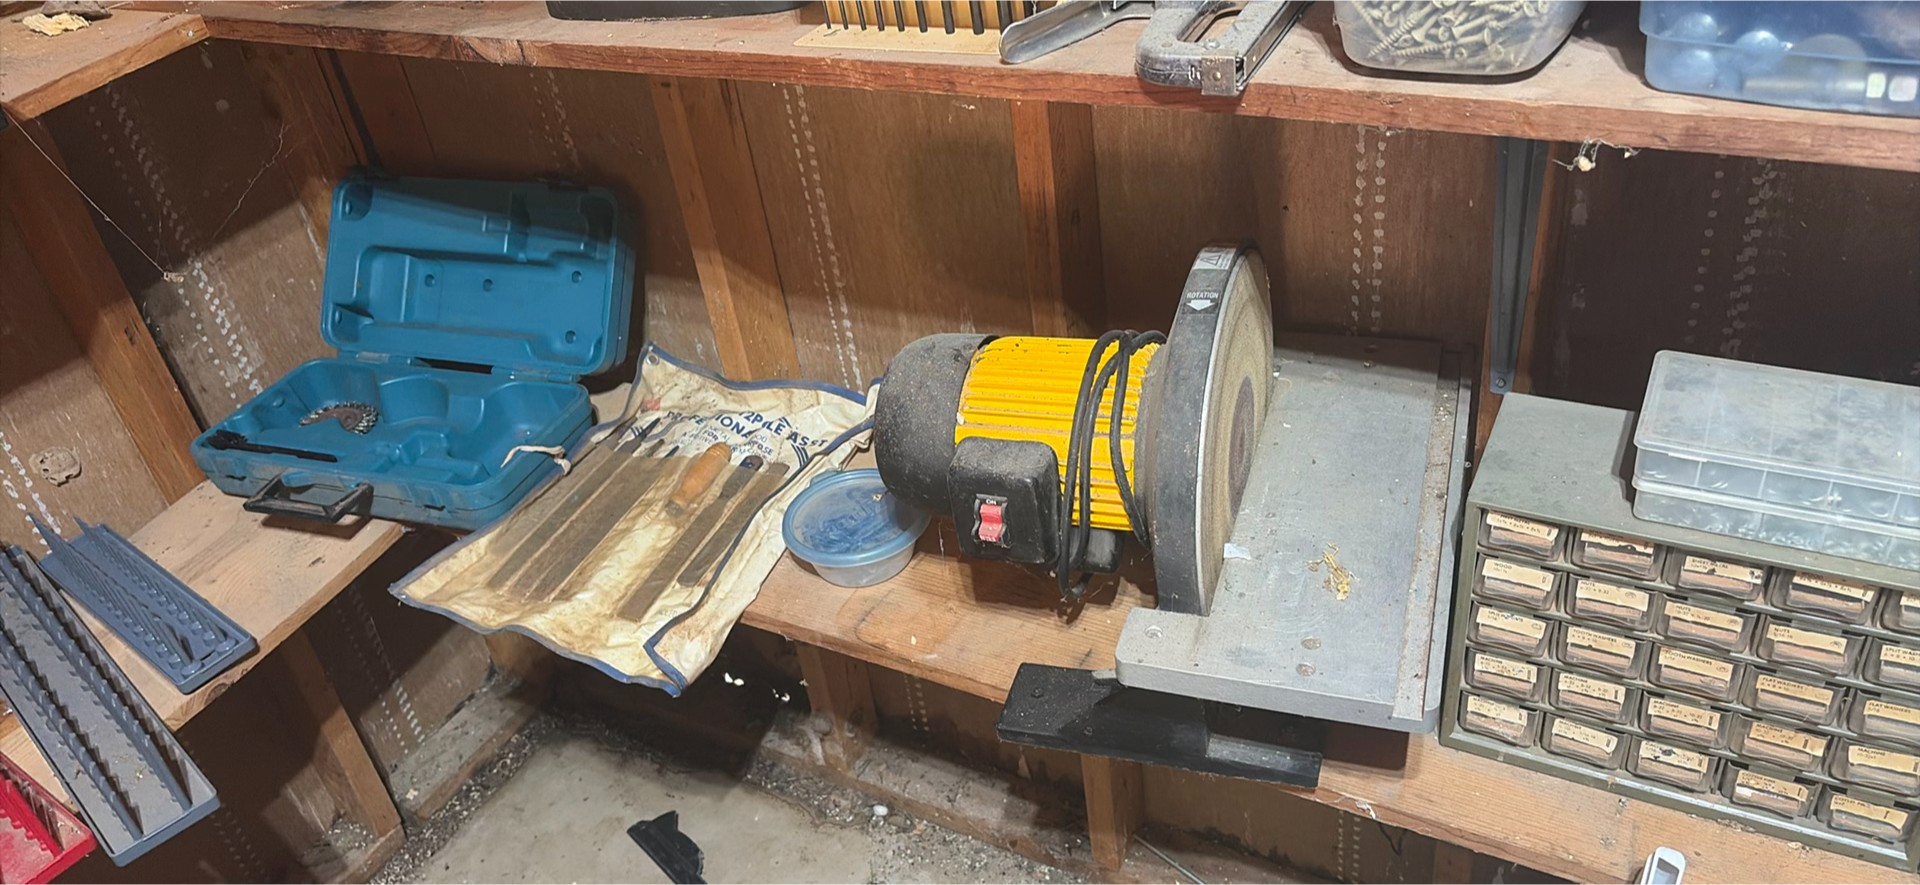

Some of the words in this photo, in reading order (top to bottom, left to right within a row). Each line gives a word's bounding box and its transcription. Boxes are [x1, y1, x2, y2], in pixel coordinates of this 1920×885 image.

[1186, 291, 1219, 299] ROTATION
[1494, 562, 1513, 570] WOOD
[1885, 646, 1900, 654] SPLIT
[1762, 677, 1777, 686] FLAT
